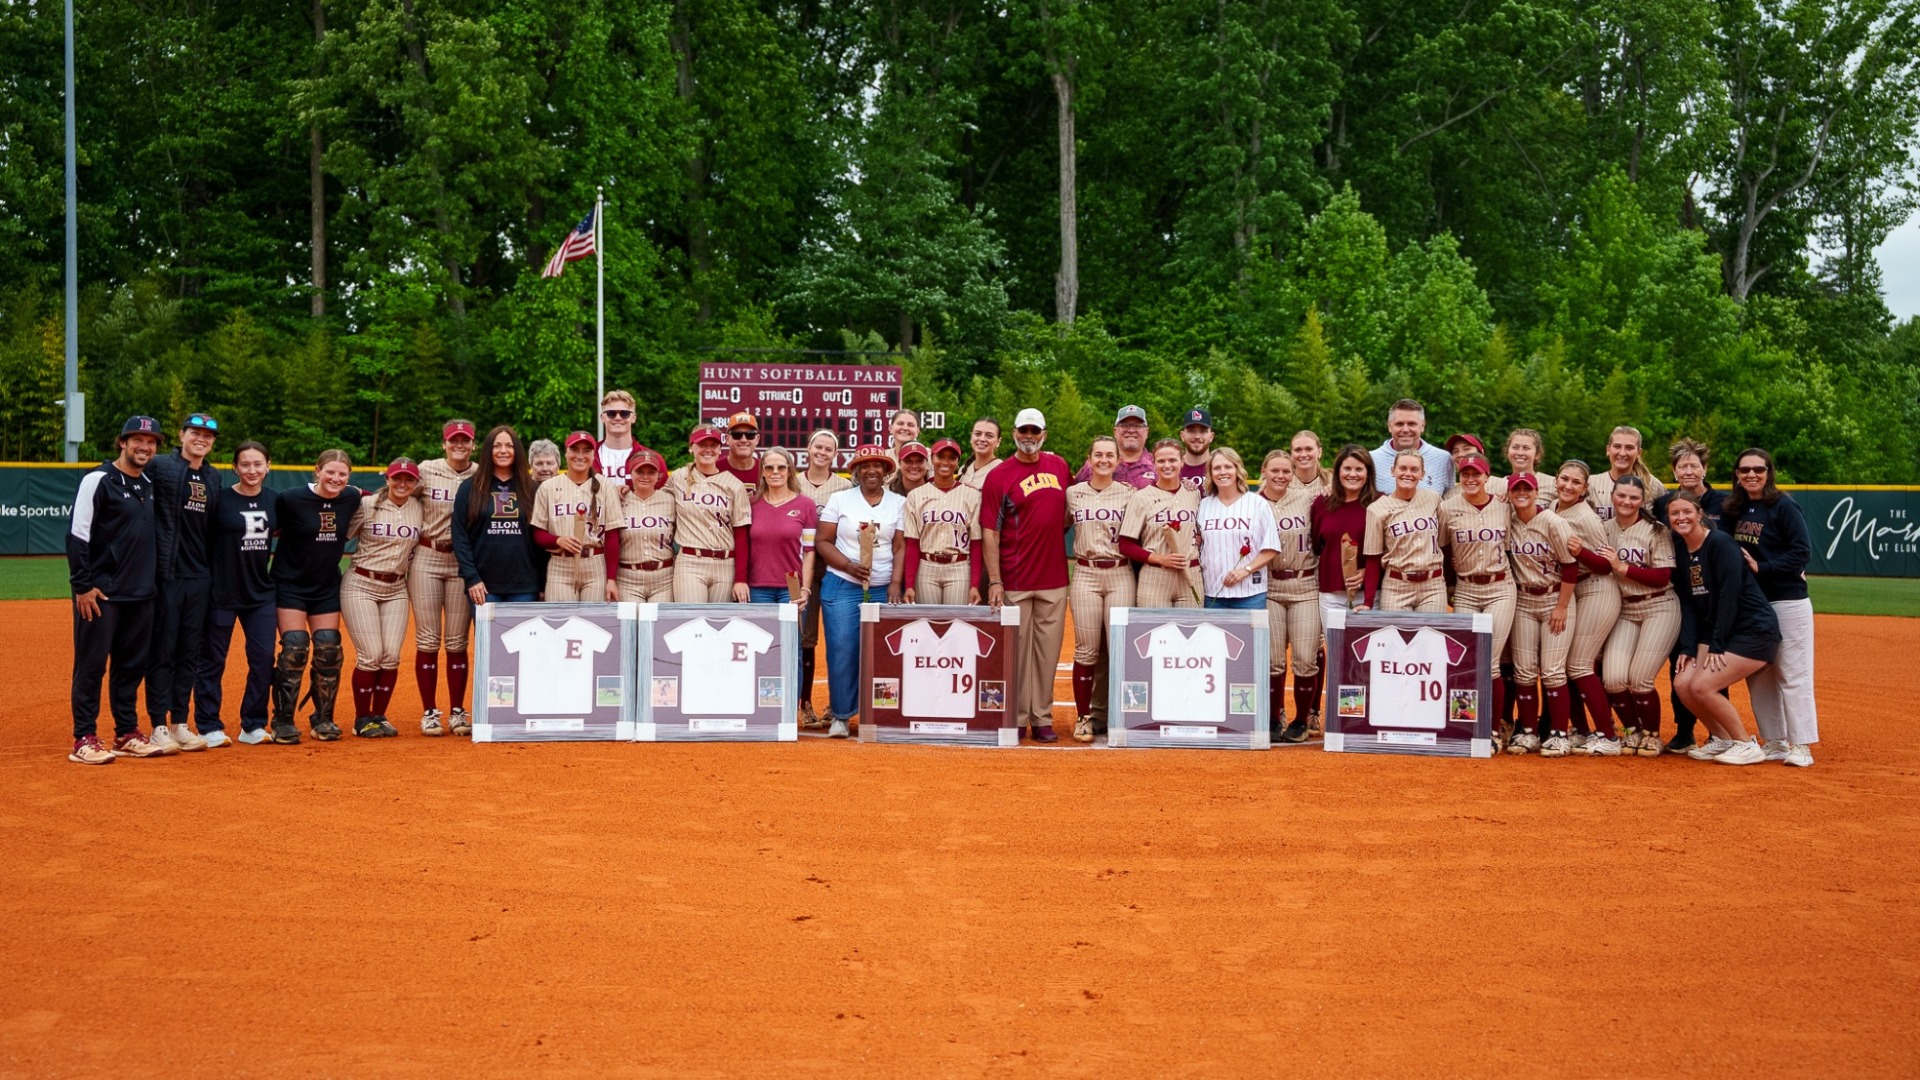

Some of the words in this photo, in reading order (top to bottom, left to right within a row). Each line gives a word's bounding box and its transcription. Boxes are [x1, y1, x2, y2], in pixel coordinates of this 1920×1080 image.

[704, 367, 753, 379] HUNT
[760, 368, 847, 381] SOFTBALL
[854, 370, 897, 382] PARK
[704, 389, 729, 400] BALL
[730, 386, 740, 403] 0
[759, 390, 792, 401] STRIKE
[793, 387, 803, 404] 0
[822, 391, 842, 402] OUT
[842, 389, 852, 405] 0
[870, 392, 887, 403] H/E
[755, 407, 761, 416] 2
[766, 407, 772, 416] 3
[780, 408, 785, 416] 4
[791, 408, 797, 416] 5
[801, 408, 807, 417] 6
[815, 408, 821, 417] 7
[825, 408, 832, 417] 8
[838, 409, 858, 418] RUNS
[865, 409, 881, 418] HITS
[140, 419, 152, 431] E
[849, 418, 857, 431] 0
[874, 419, 882, 431] 0
[849, 434, 857, 447] 0
[188, 482, 206, 502] E
[1020, 472, 1063, 497] ELON
[0, 504, 18, 516] ke
[20, 504, 60, 519] Sports
[187, 501, 206, 509] ELON
[922, 509, 967, 526] ELON
[1074, 508, 1125, 522] ELON
[1890, 509, 1907, 519] THE
[240, 511, 269, 540] E
[319, 512, 337, 532] E
[491, 521, 519, 529] ELON
[624, 515, 670, 529] LON
[1203, 517, 1251, 532] ELON
[1277, 515, 1306, 530] ON
[953, 529, 970, 549] 19
[1511, 541, 1549, 555] LON
[1618, 548, 1644, 561] ON
[1878, 543, 1889, 552] AT
[1894, 543, 1917, 553] ELON
[564, 639, 582, 659] E
[731, 642, 748, 662] E
[915, 656, 964, 668] ELON
[1163, 657, 1213, 669] ELON
[1380, 661, 1432, 675] ELON
[952, 674, 973, 694] 19
[1204, 674, 1216, 694] 3
[1420, 680, 1442, 701] 10
